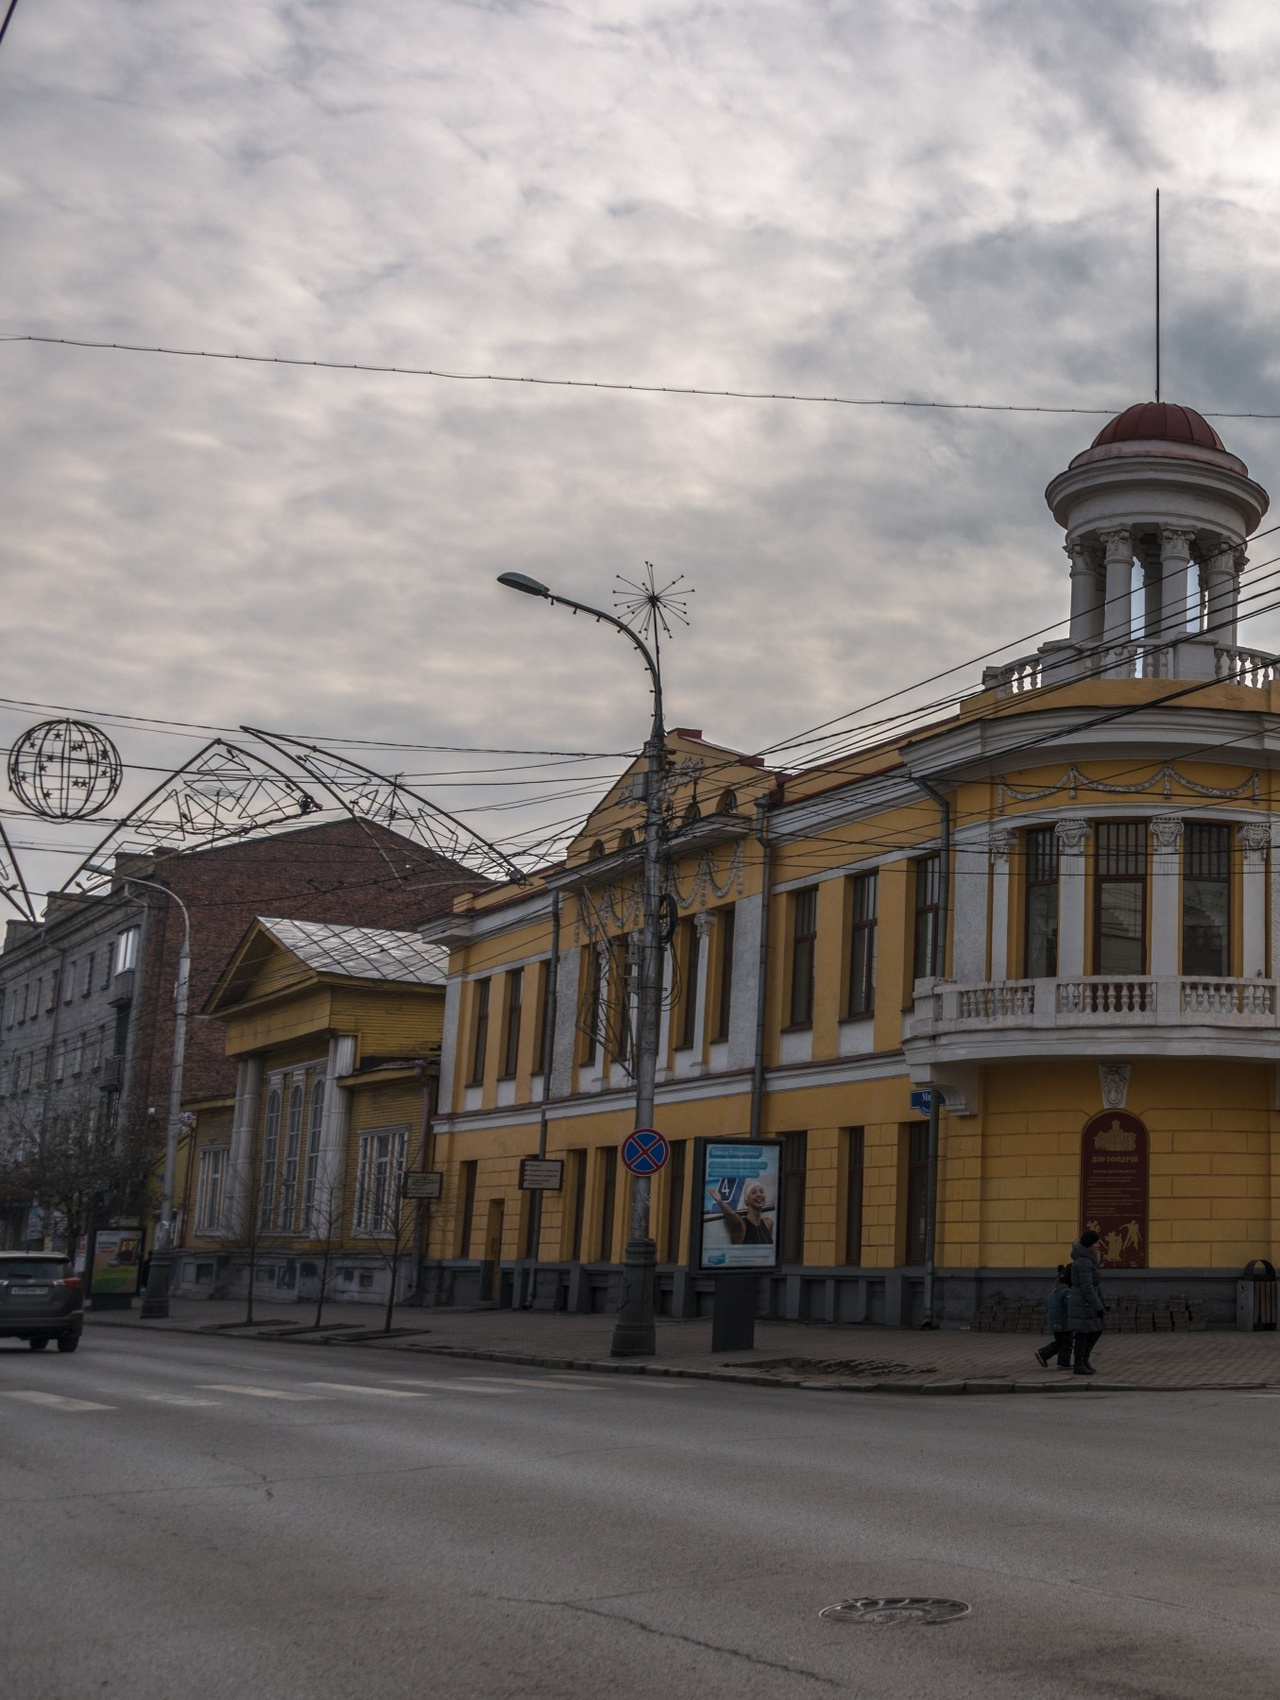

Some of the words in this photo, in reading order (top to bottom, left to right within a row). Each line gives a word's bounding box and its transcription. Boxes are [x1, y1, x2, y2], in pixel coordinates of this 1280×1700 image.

[1091, 1156, 1105, 1164] ДОМ
[1106, 1156, 1139, 1164] ОФИЦЕРОВ
[721, 1177, 730, 1197] 4
